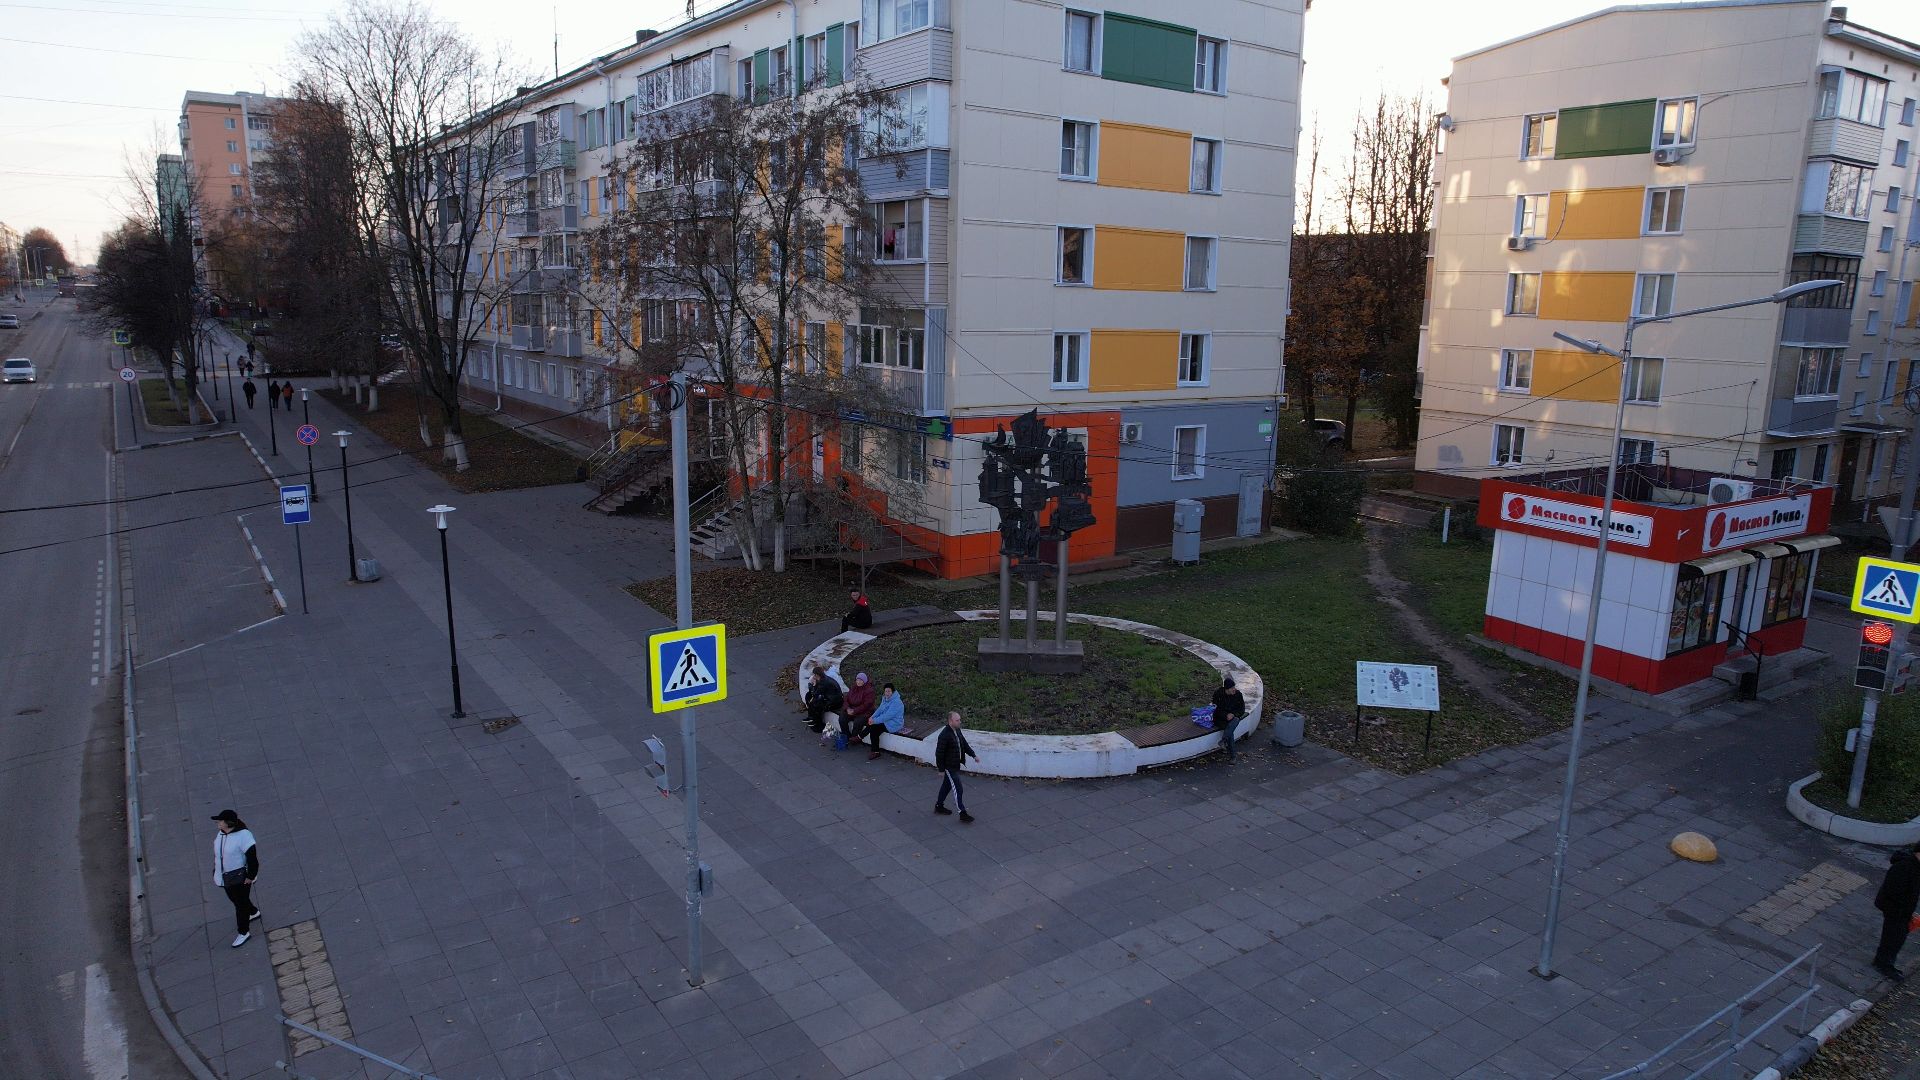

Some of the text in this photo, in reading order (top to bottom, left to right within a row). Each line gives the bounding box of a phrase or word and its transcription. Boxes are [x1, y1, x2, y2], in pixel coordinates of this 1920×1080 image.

[1532, 505, 1587, 525] Мясная
[1729, 509, 1800, 533] Мясная Точка
